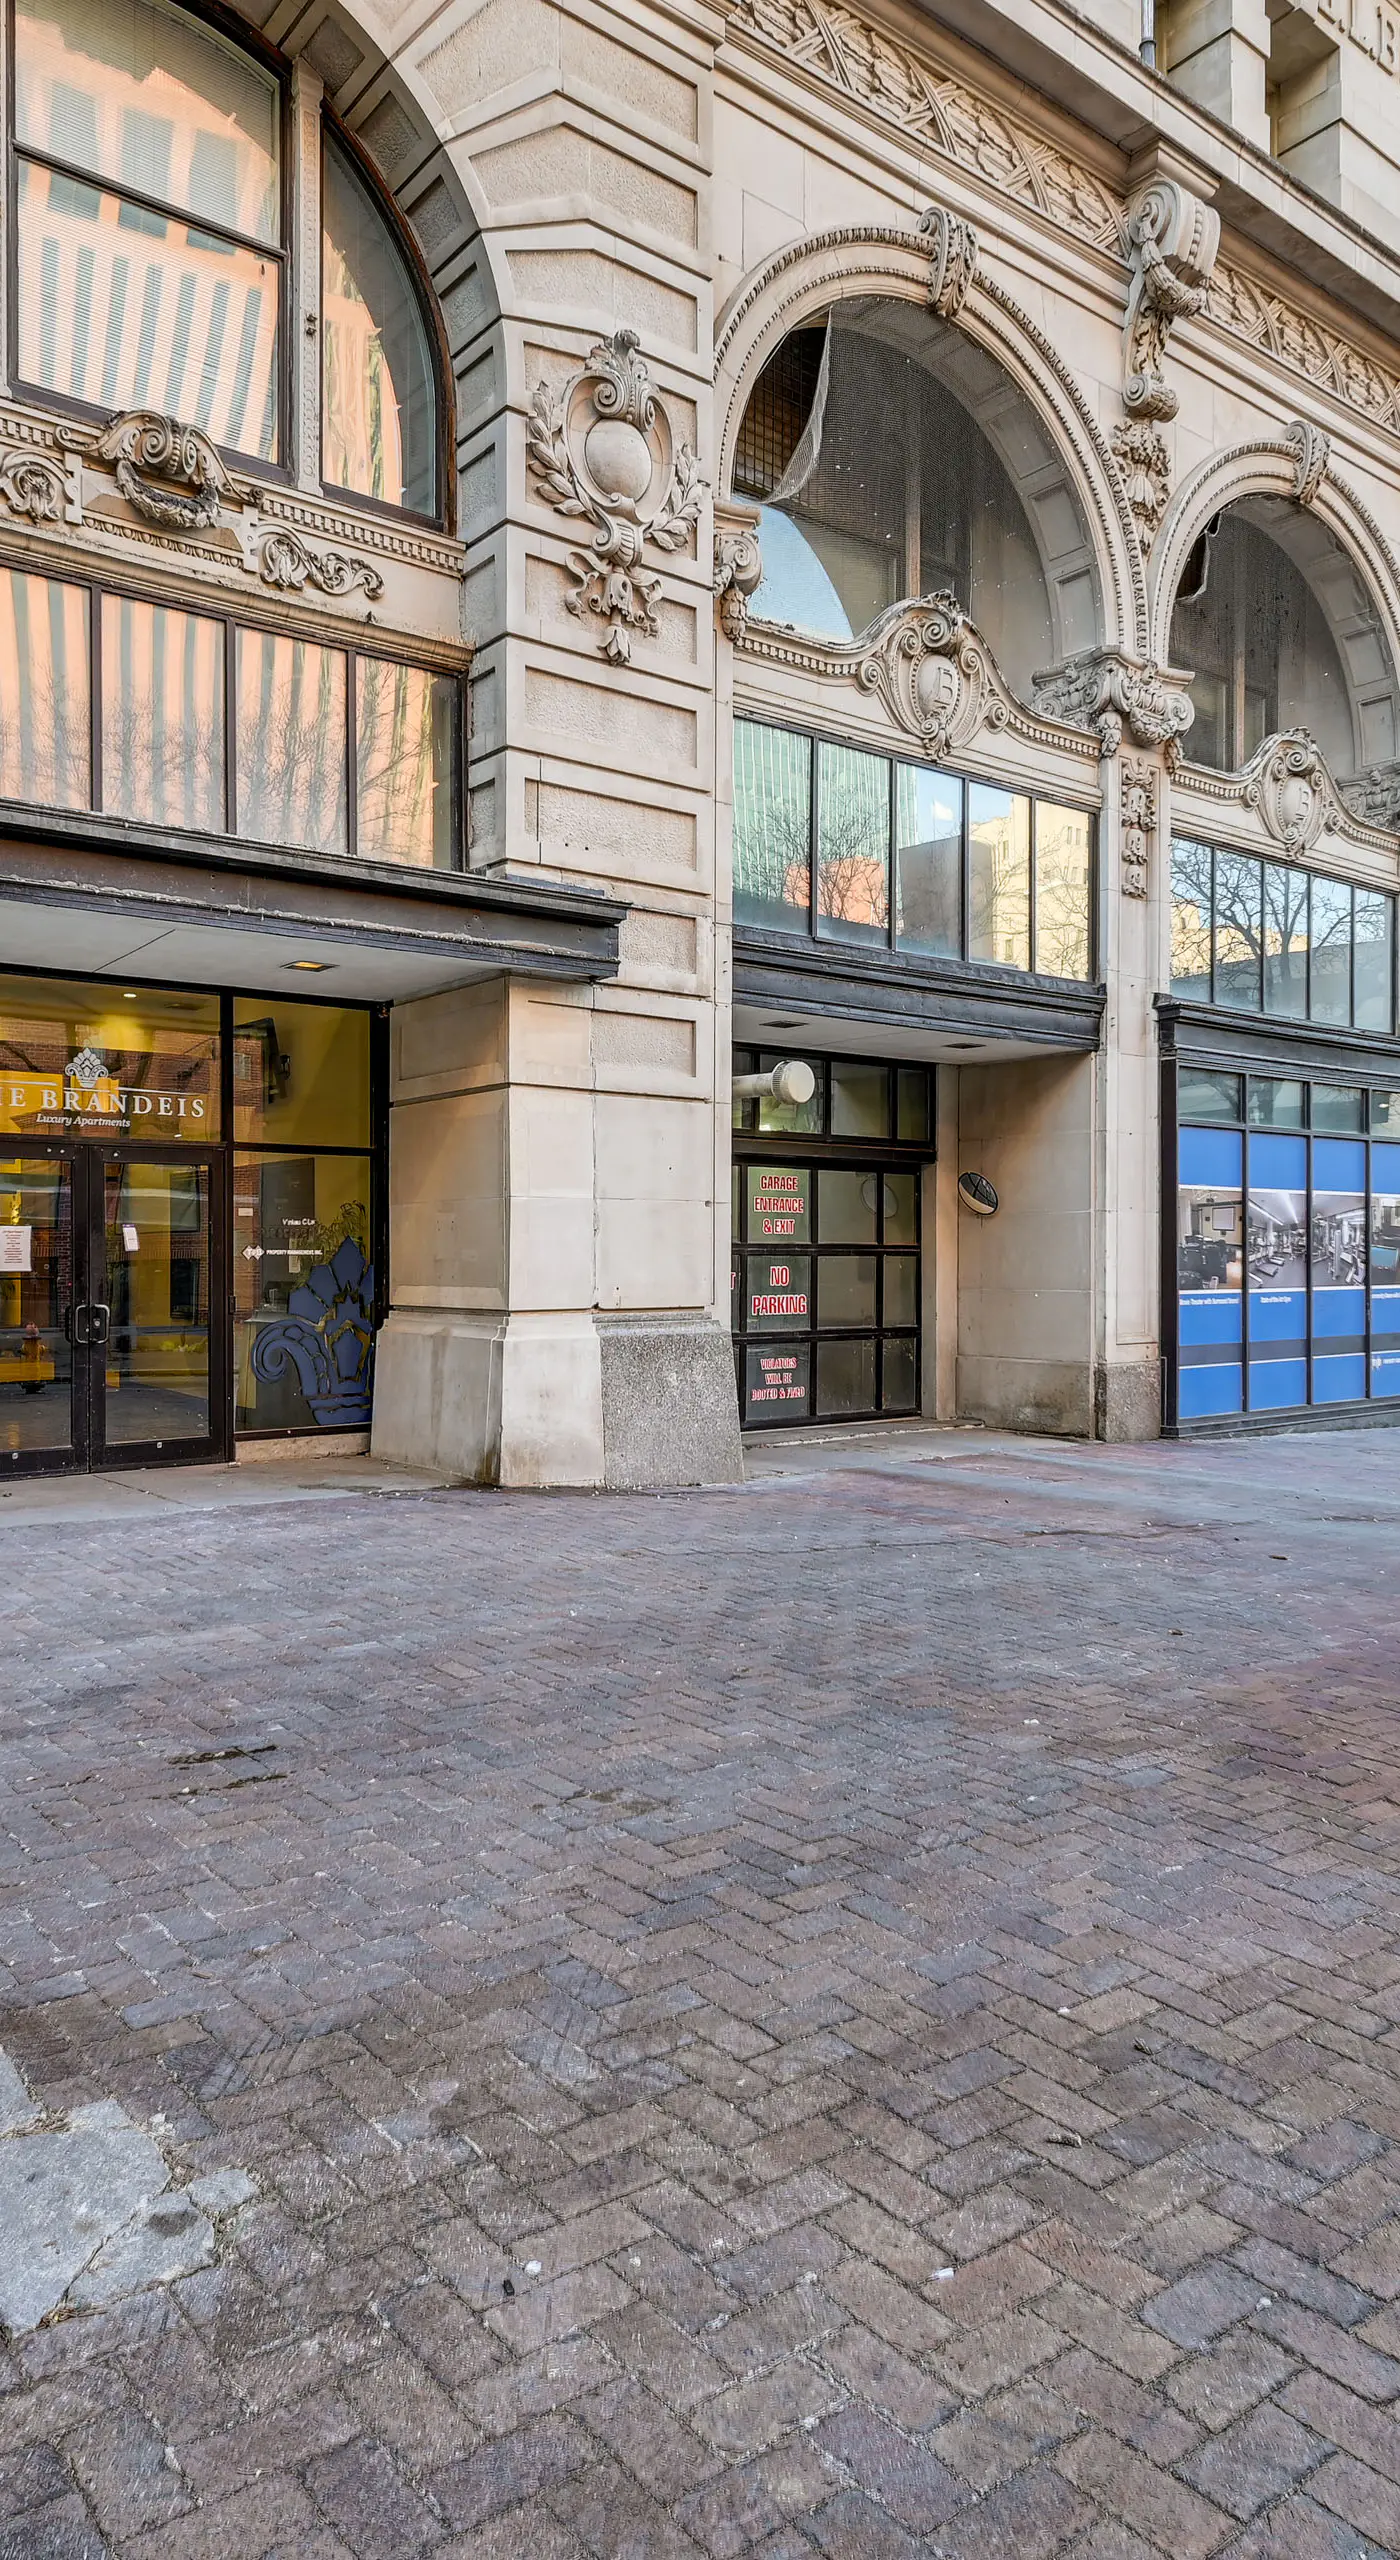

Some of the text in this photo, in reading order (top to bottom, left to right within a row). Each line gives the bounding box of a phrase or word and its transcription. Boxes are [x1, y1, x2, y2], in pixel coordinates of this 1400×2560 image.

[41, 1089, 205, 1118] BRANDEIS
[36, 1113, 131, 1127] Luxury Apartments
[760, 1174, 798, 1191] GARAGE
[753, 1196, 804, 1213] ENTRANCE
[763, 1218, 795, 1235] & EXIT
[770, 1266, 790, 1286] NO
[752, 1294, 807, 1316] PARKING
[765, 1372, 793, 1385] WILL BE
[779, 1387, 786, 1399] &
